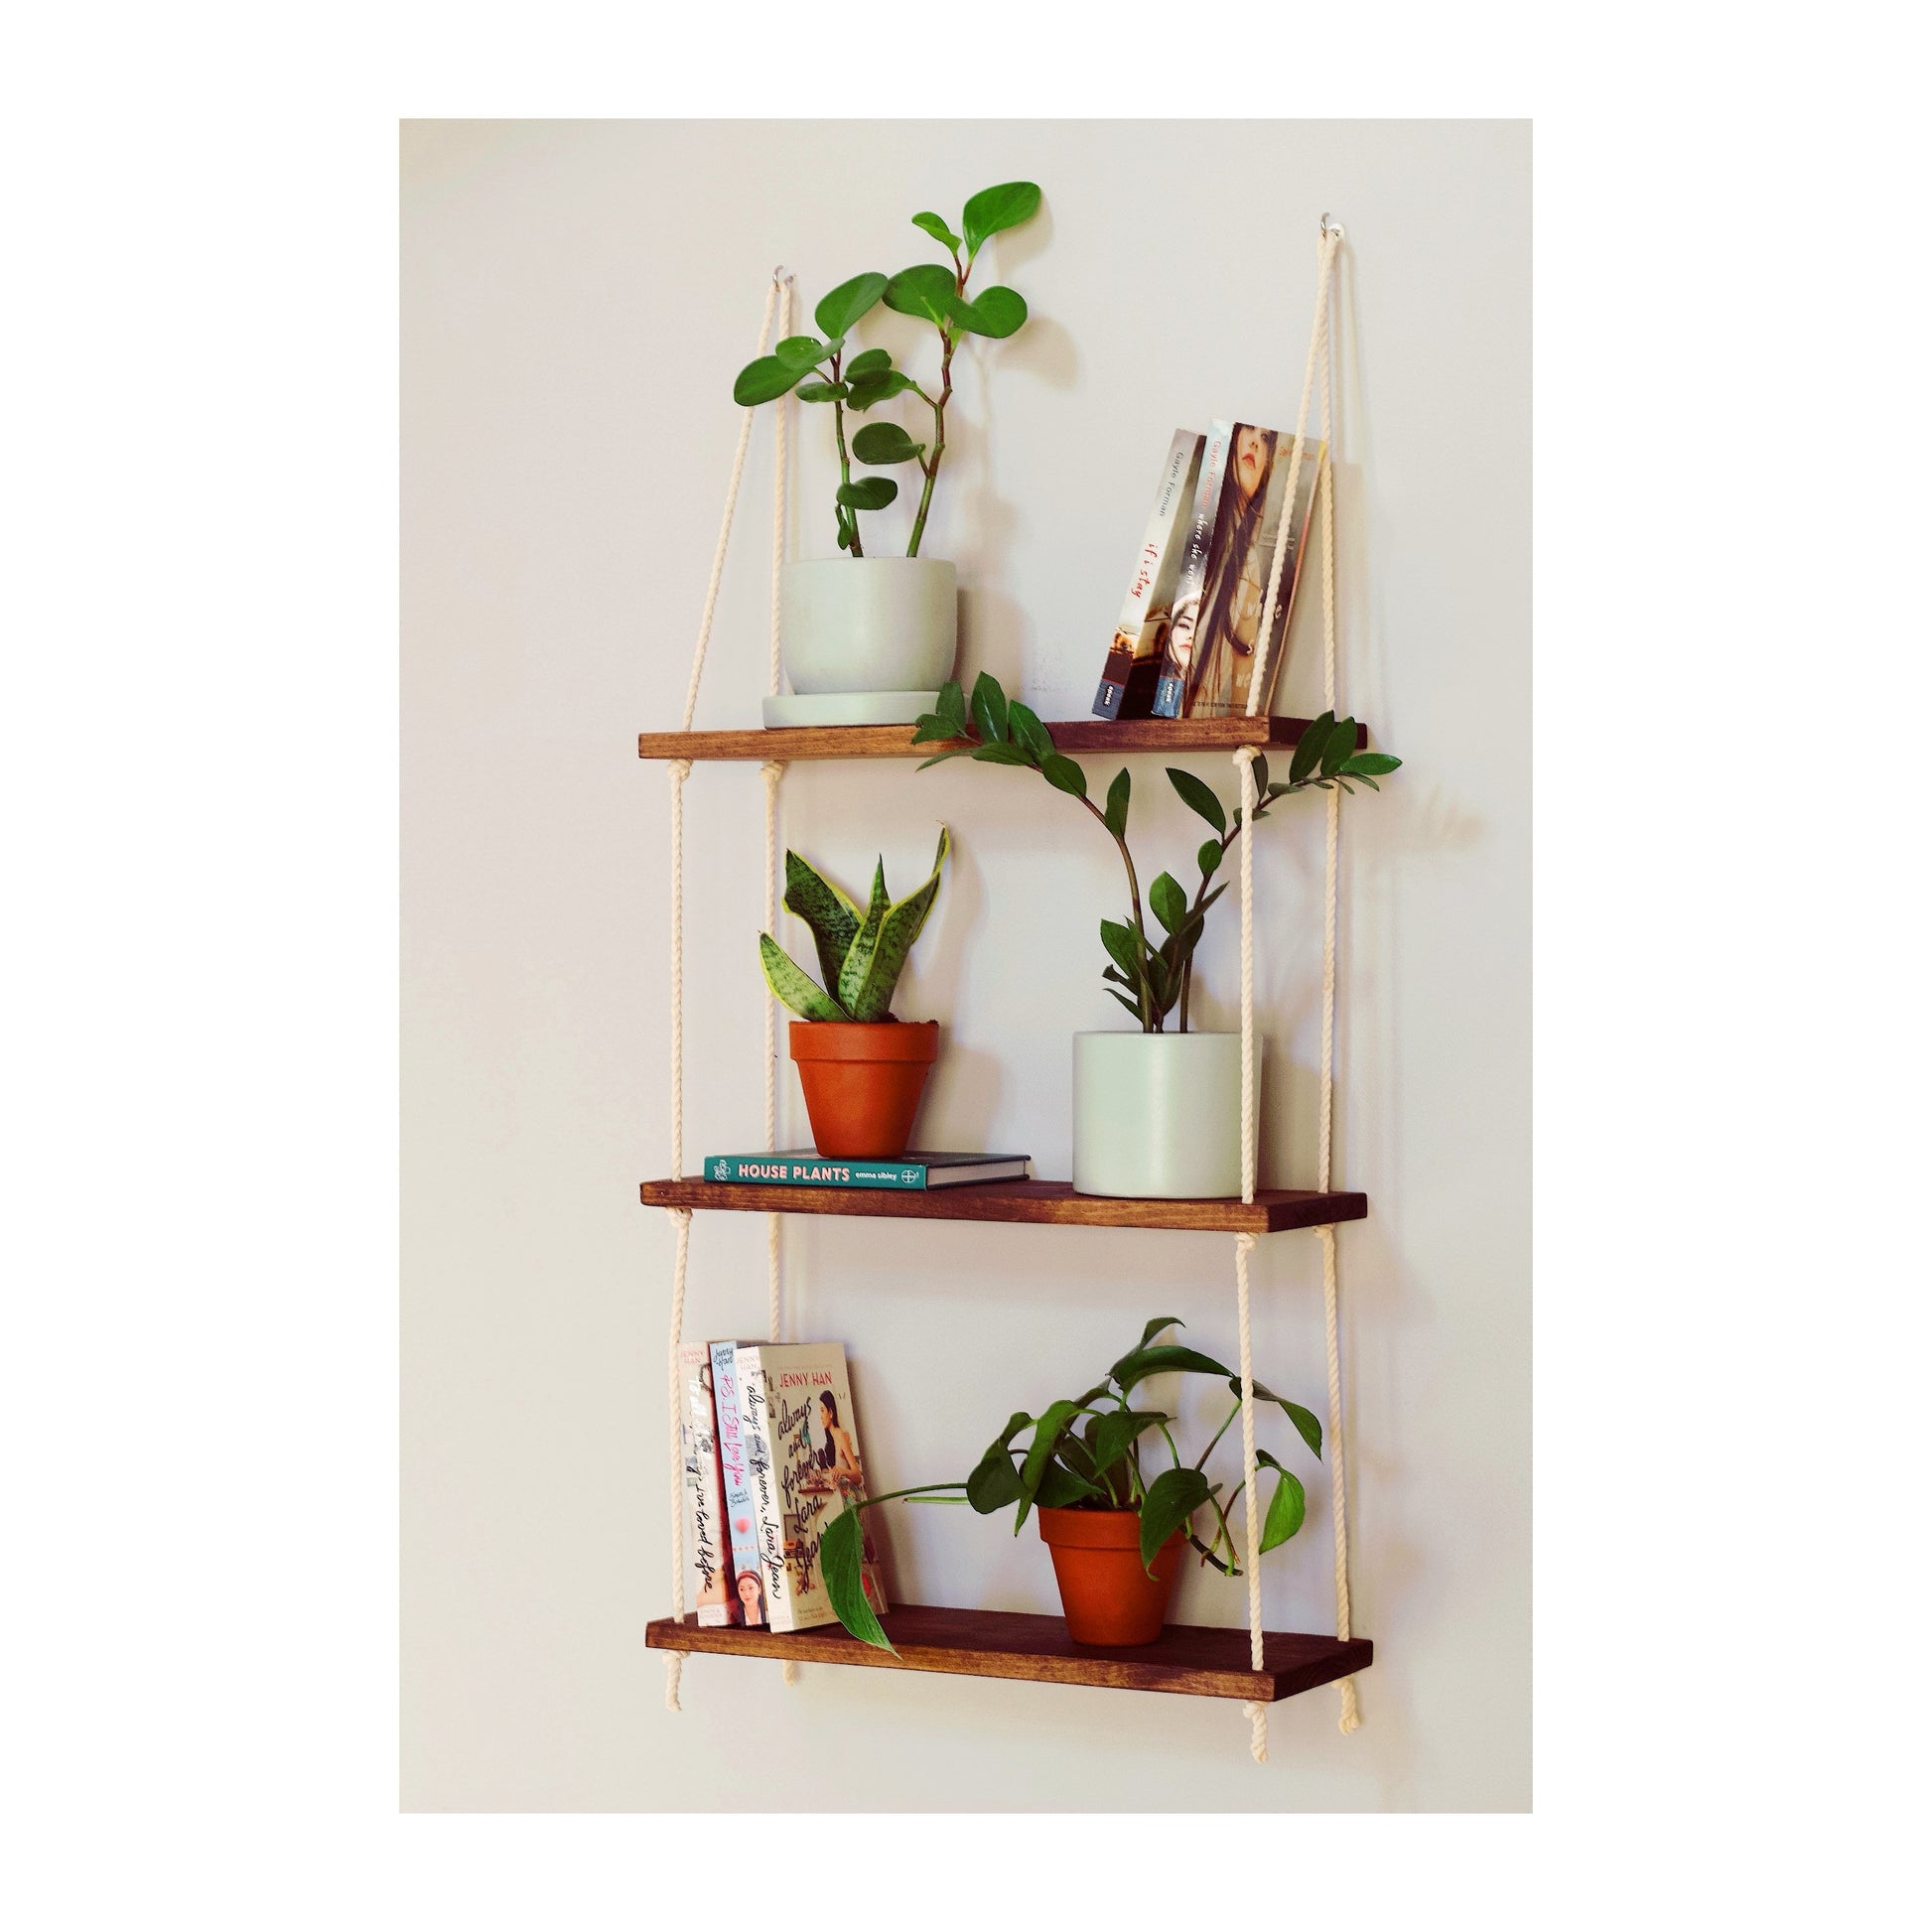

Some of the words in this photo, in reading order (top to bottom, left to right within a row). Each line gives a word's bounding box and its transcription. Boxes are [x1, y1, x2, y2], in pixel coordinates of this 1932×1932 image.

[1173, 452, 1184, 479] Gayle
[1210, 440, 1222, 468] Gayle
[1160, 482, 1175, 517] Forman
[1201, 472, 1216, 508] Forman
[1195, 513, 1209, 541] where
[1144, 543, 1159, 559] if
[1191, 543, 1203, 560] she
[1131, 570, 1151, 599] stay
[738, 1164, 788, 1178] HOUSE
[793, 1166, 850, 1181] PLANTS
[877, 1172, 897, 1181] sibley
[779, 1372, 808, 1388] JENNY
[812, 1371, 832, 1385] HAN
[722, 1402, 737, 1414] I
[743, 1386, 765, 1432] always
[778, 1397, 812, 1441] always
[696, 1509, 713, 1546] loved
[760, 1515, 778, 1554] Lara
[695, 1546, 716, 1592] before
[760, 1552, 784, 1599] Jean
